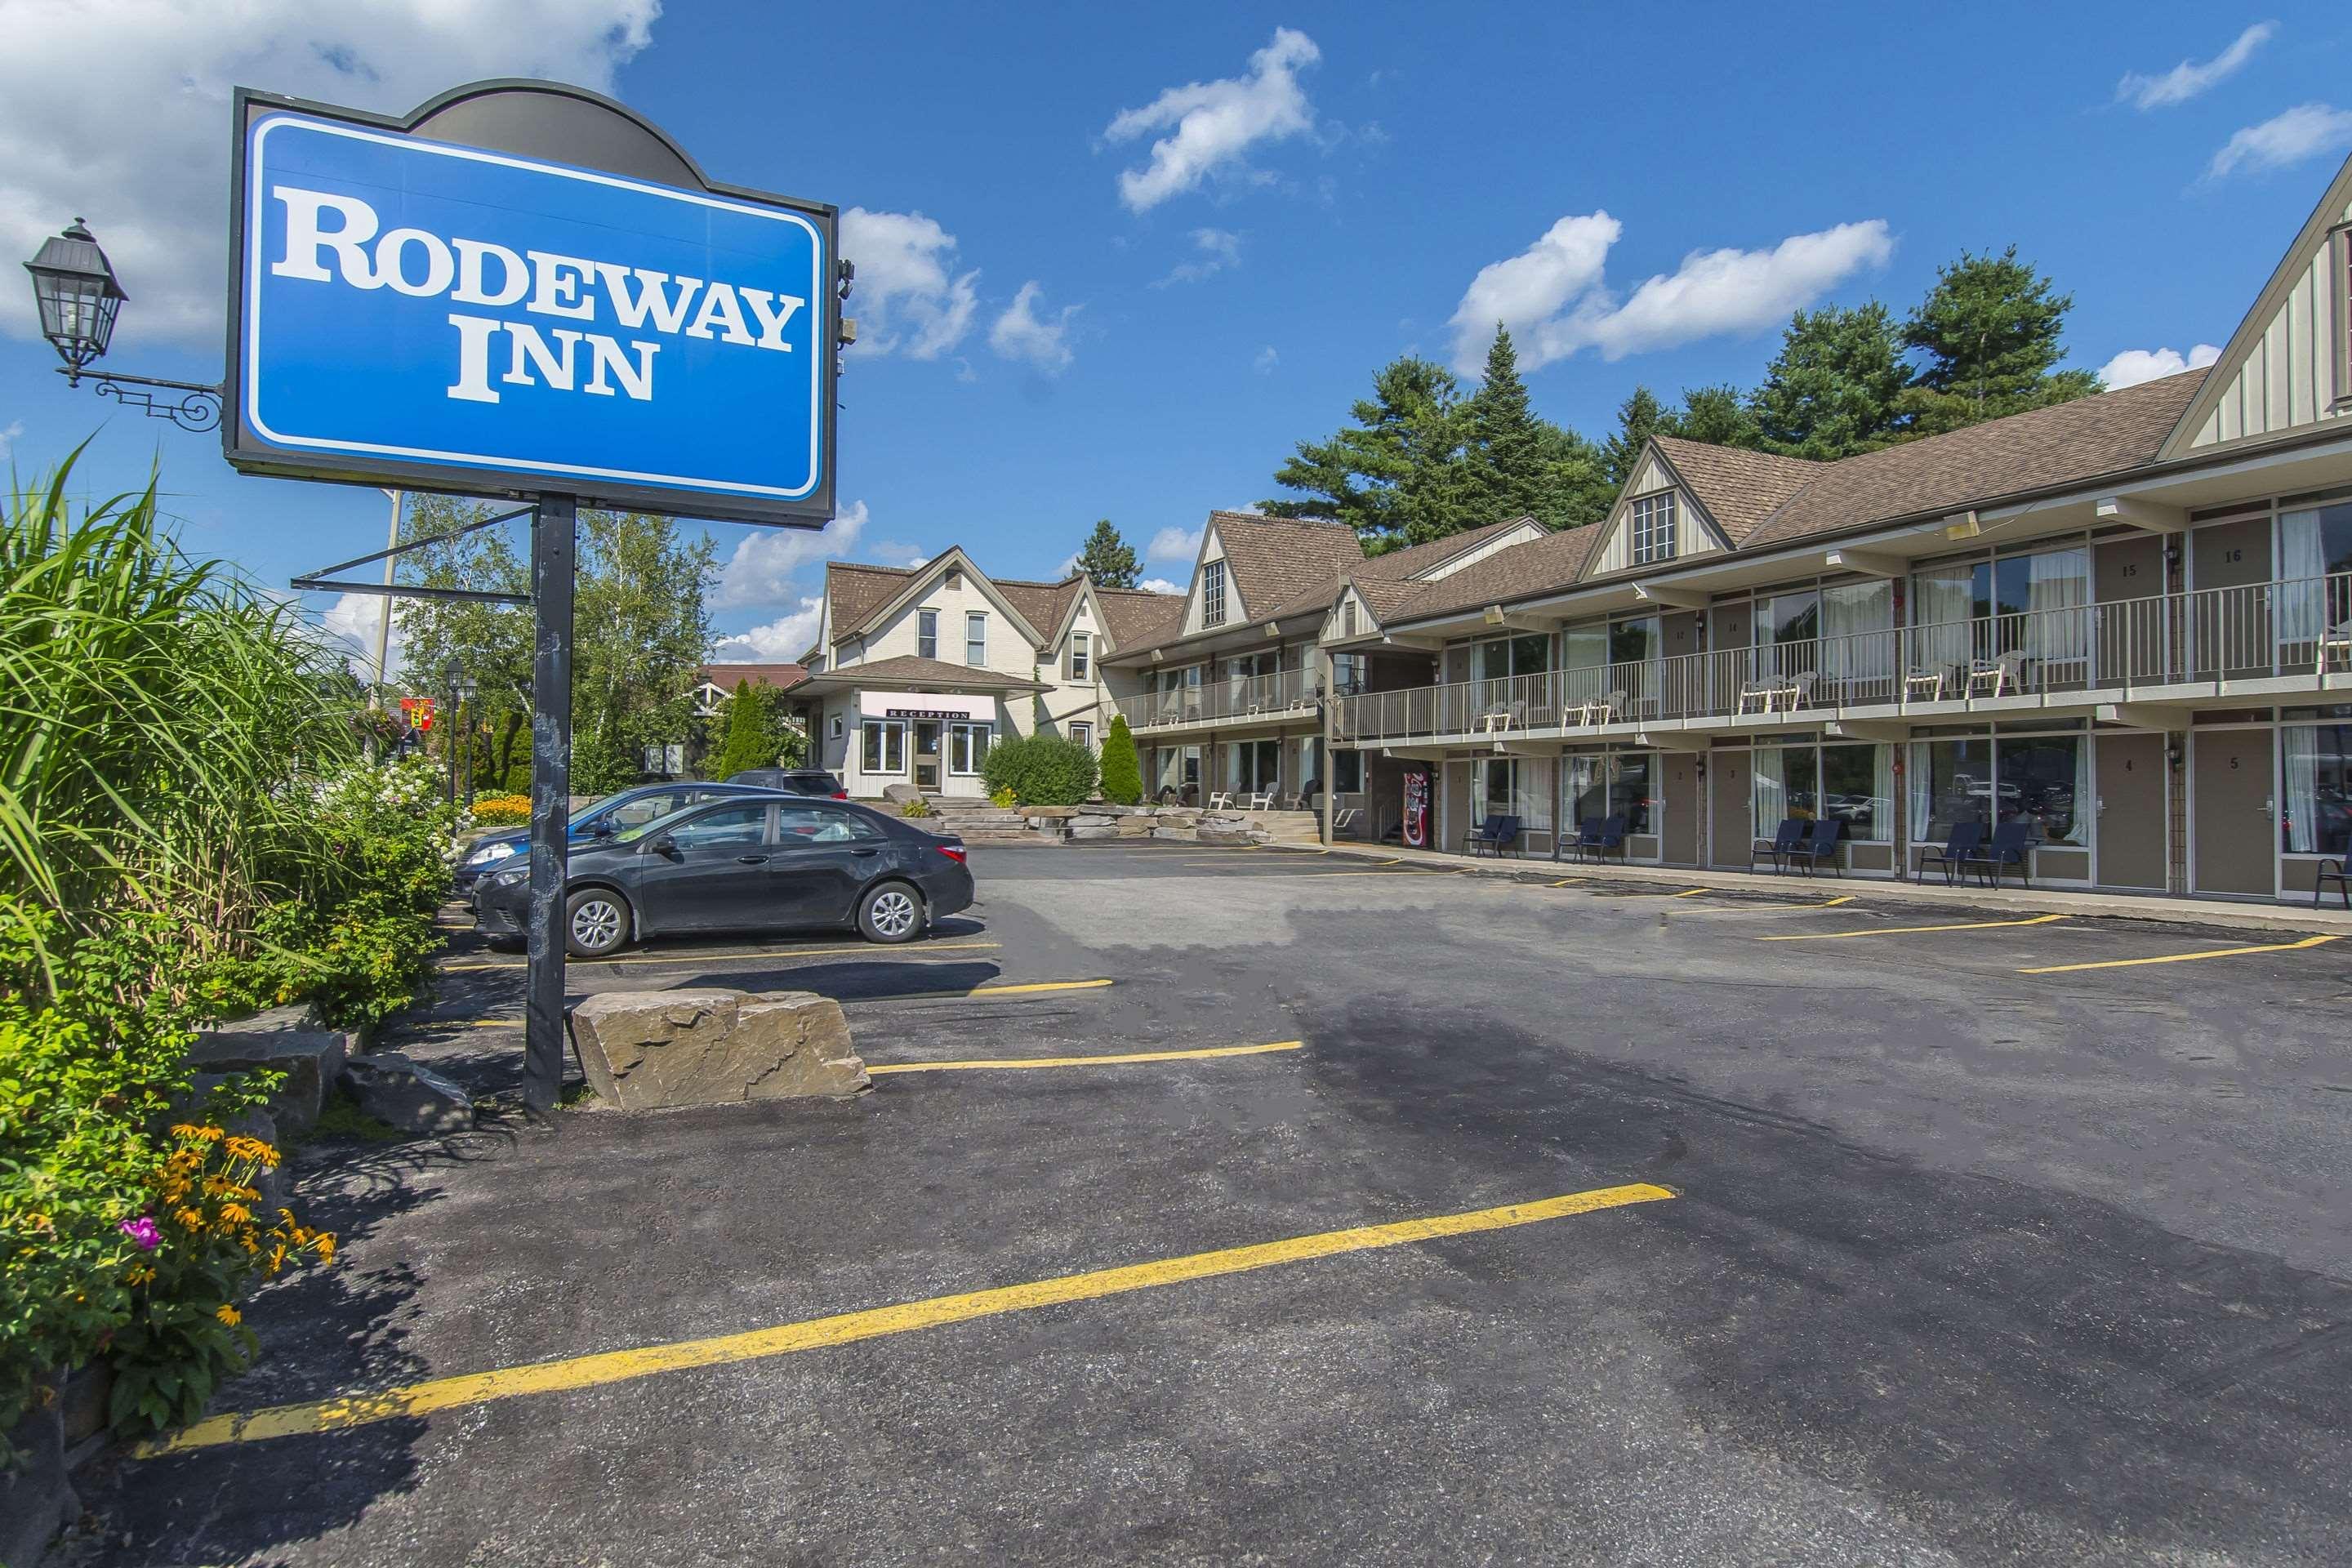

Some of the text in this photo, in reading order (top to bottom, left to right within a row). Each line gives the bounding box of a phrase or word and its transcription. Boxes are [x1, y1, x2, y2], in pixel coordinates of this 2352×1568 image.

[272, 185, 805, 353] RODEWAY
[447, 314, 662, 404] INN
[2225, 550, 2242, 564] 16
[2123, 564, 2136, 577] 15
[889, 710, 969, 719] RECEPTION
[2126, 760, 2132, 772] 4
[2230, 757, 2238, 769] 5
